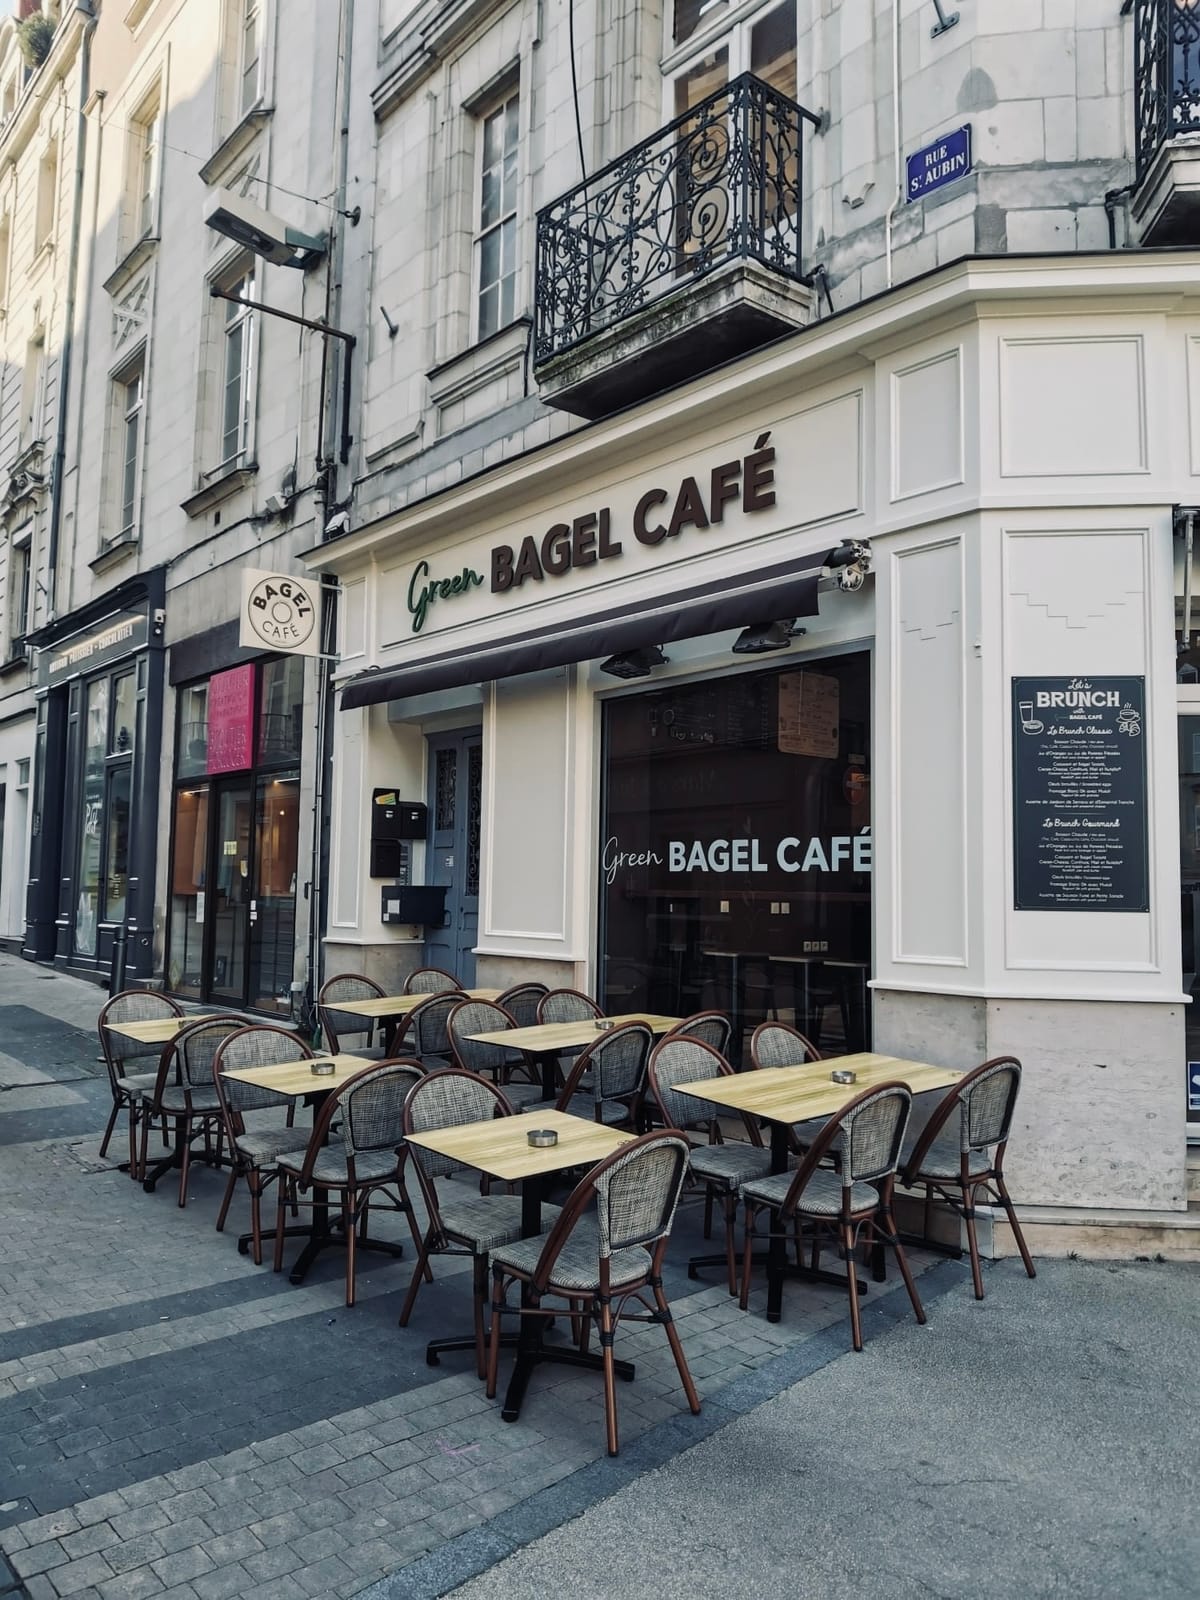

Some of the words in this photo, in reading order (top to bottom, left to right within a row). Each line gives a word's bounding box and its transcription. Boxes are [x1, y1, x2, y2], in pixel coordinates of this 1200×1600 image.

[925, 145, 948, 166] RUE
[925, 152, 964, 186] AUBIN
[408, 560, 484, 632] Green
[490, 507, 622, 593] BAGEL
[633, 431, 776, 546] CAFÉ
[253, 582, 310, 618] BAGEL
[262, 620, 300, 639] CAFÉ
[1068, 678, 1092, 690] Let's
[1036, 691, 1120, 708] BRUNCH
[1058, 726, 1086, 734] Brunch
[1086, 726, 1112, 734] Classic
[1054, 818, 1080, 827] Brunch
[1082, 818, 1120, 827] Gourmand
[602, 836, 663, 884] Green
[669, 838, 768, 872] BAGEL
[776, 826, 872, 872] CAFÉ
